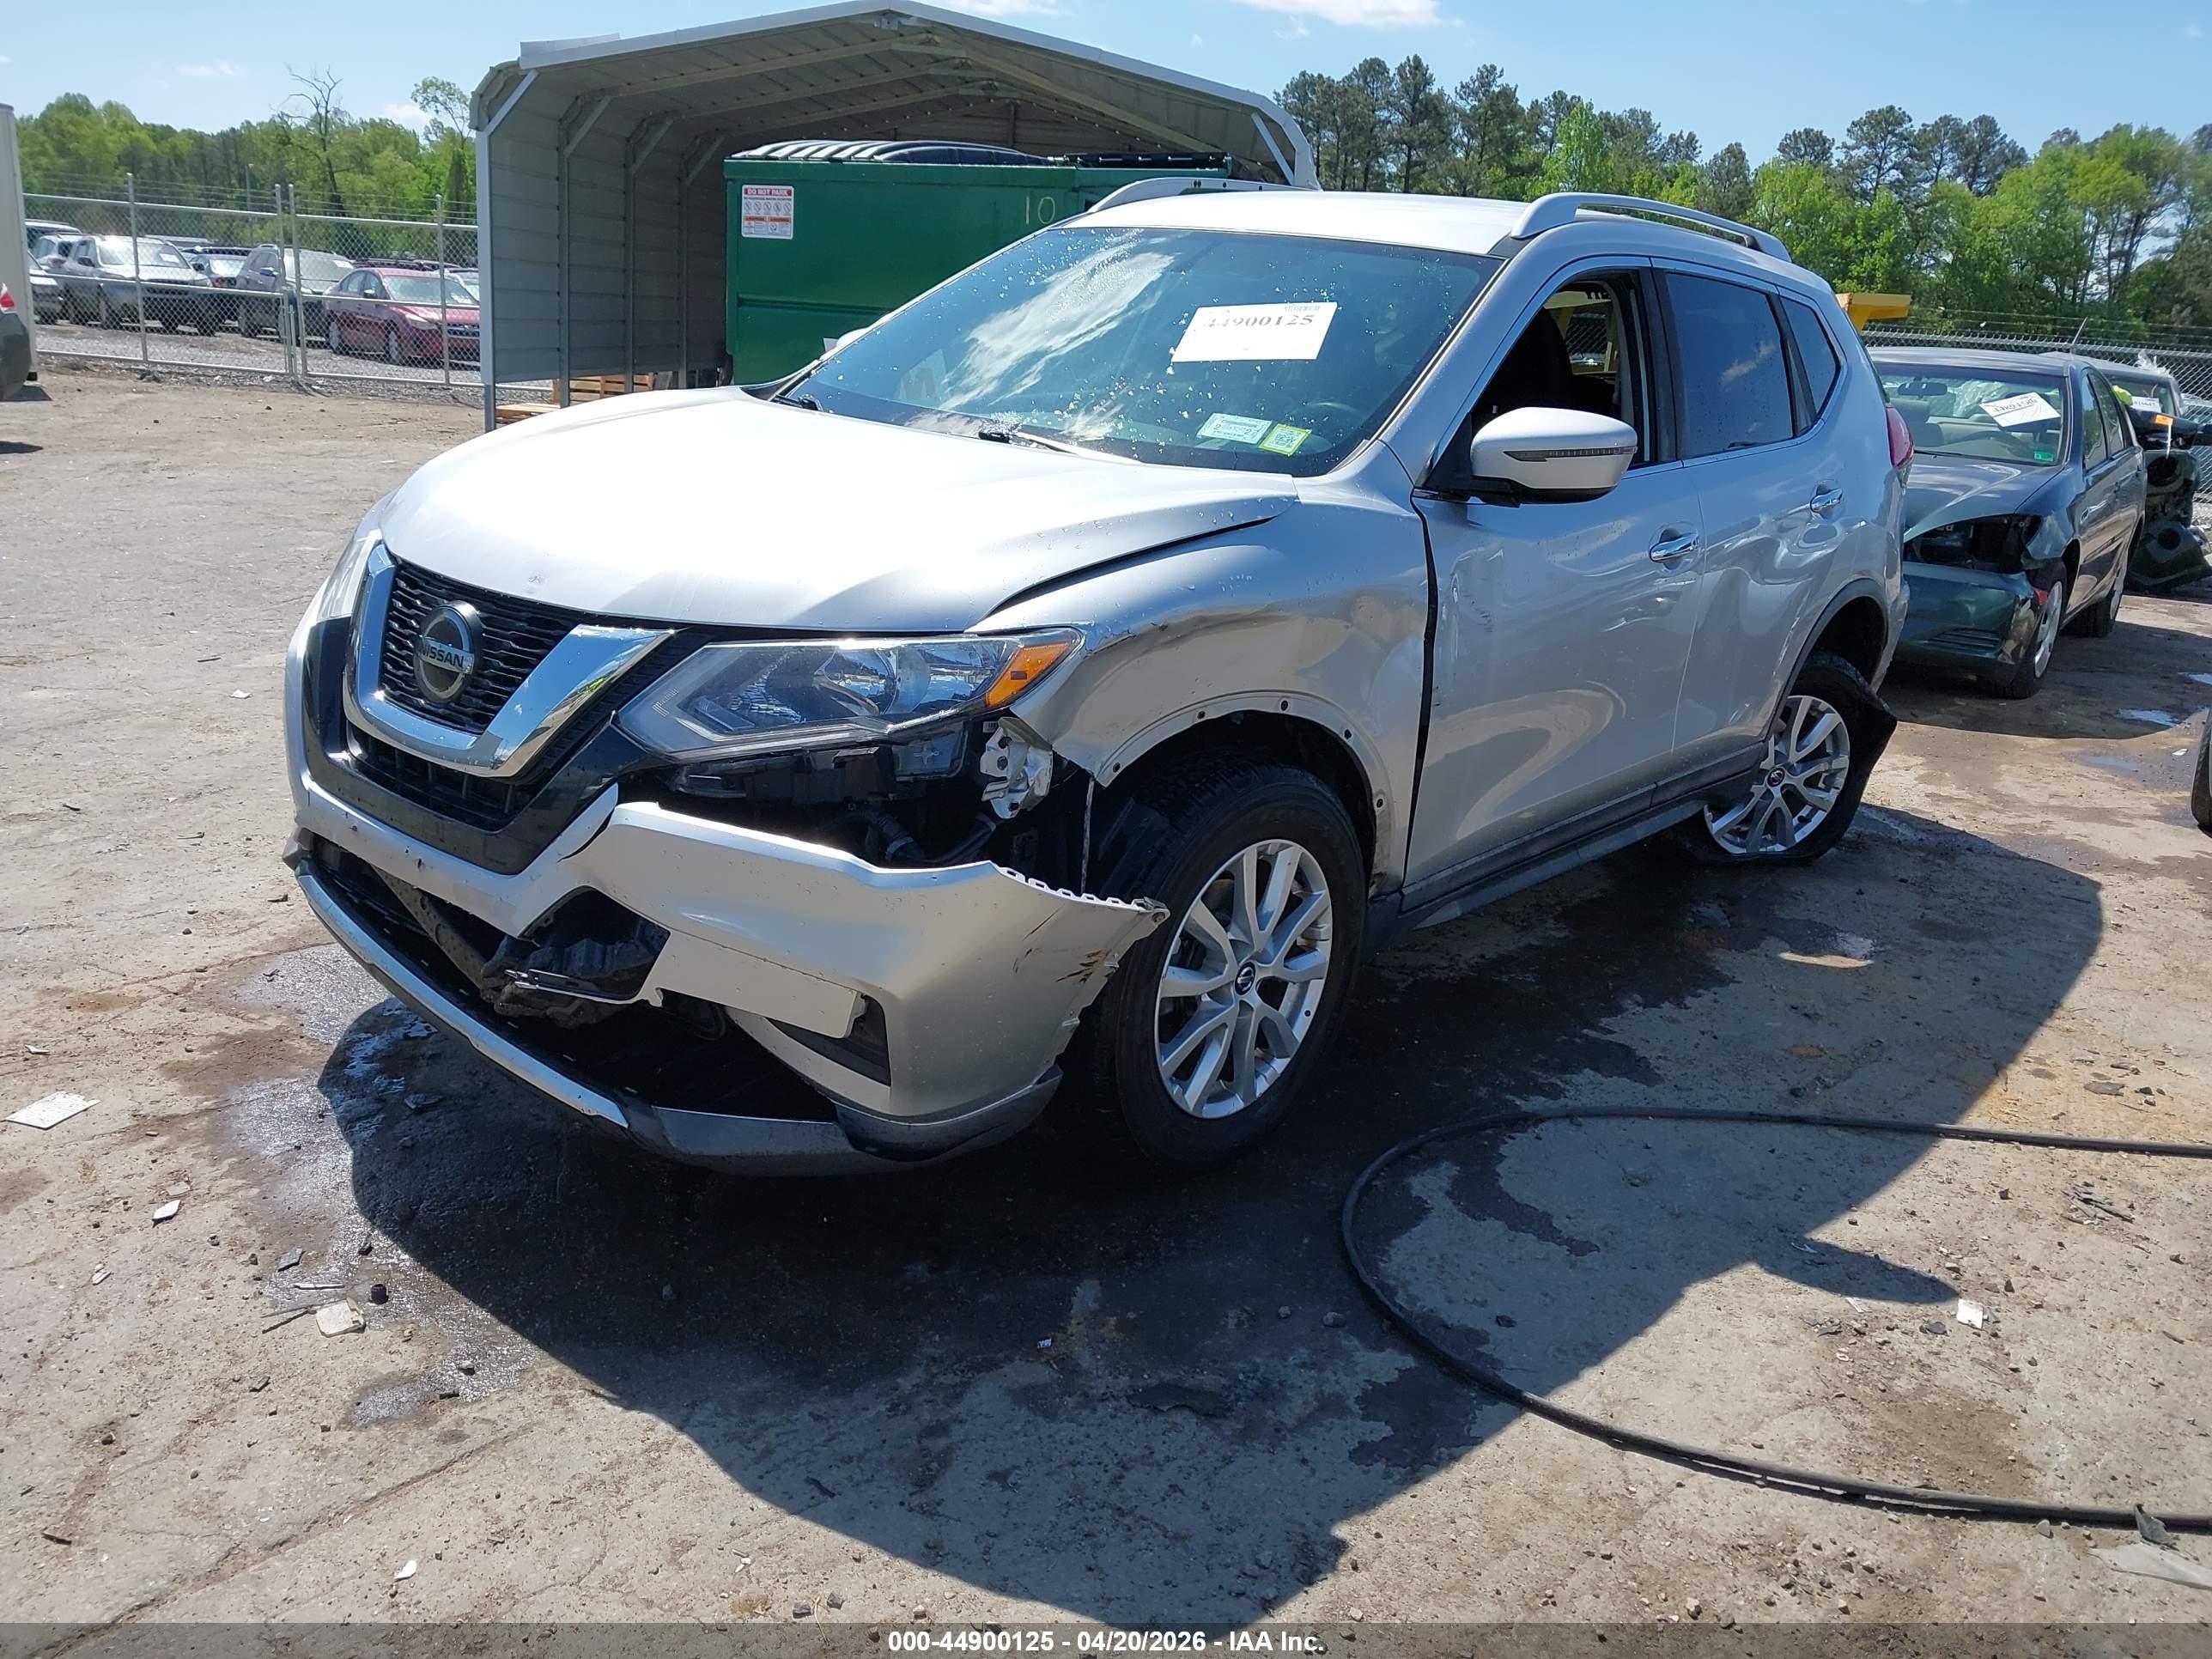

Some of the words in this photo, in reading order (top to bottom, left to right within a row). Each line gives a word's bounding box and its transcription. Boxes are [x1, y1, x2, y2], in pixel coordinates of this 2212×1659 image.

[1025, 196, 1055, 225] 10
[1203, 314, 1315, 328] 44900125
[421, 643, 464, 668] NISSAN
